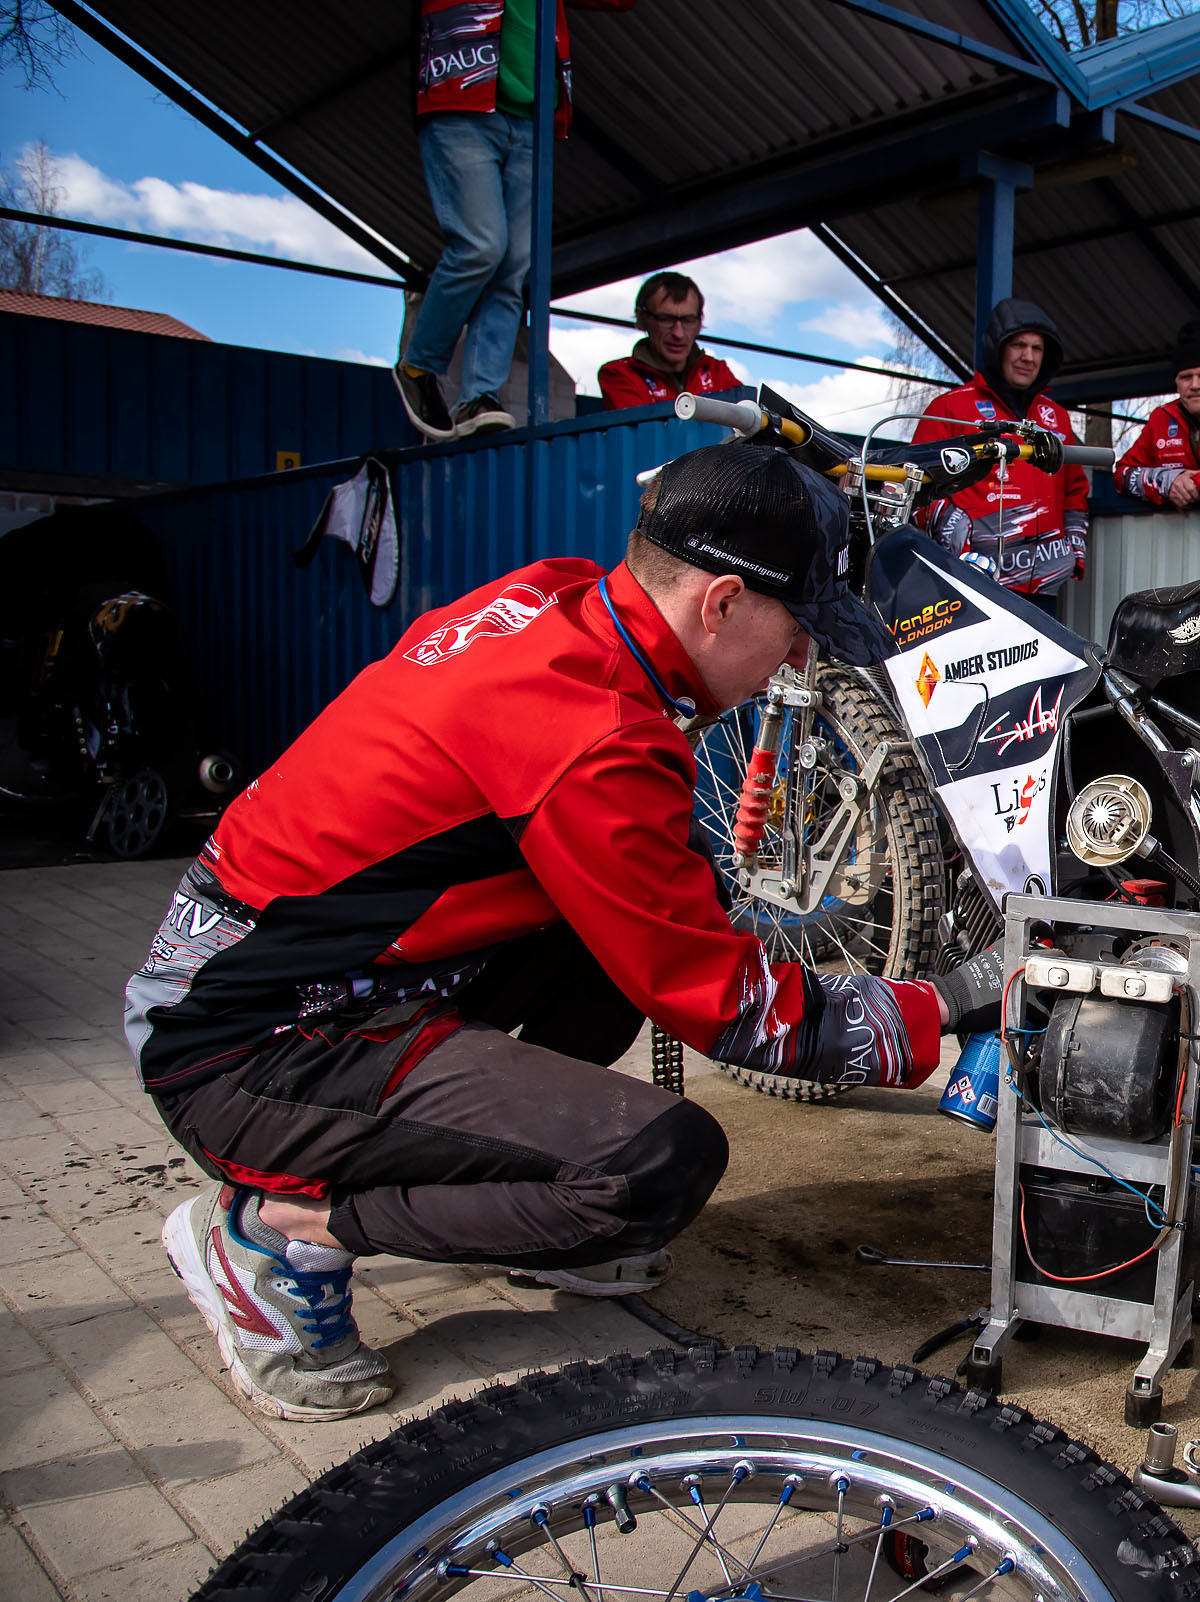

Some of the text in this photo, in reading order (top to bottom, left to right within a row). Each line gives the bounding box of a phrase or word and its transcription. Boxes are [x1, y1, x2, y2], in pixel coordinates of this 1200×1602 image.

[430, 45, 496, 78] DAUG
[885, 600, 963, 637] Van2Go
[898, 615, 954, 646] LONDON
[944, 638, 1040, 682] AMBER STUDIOS
